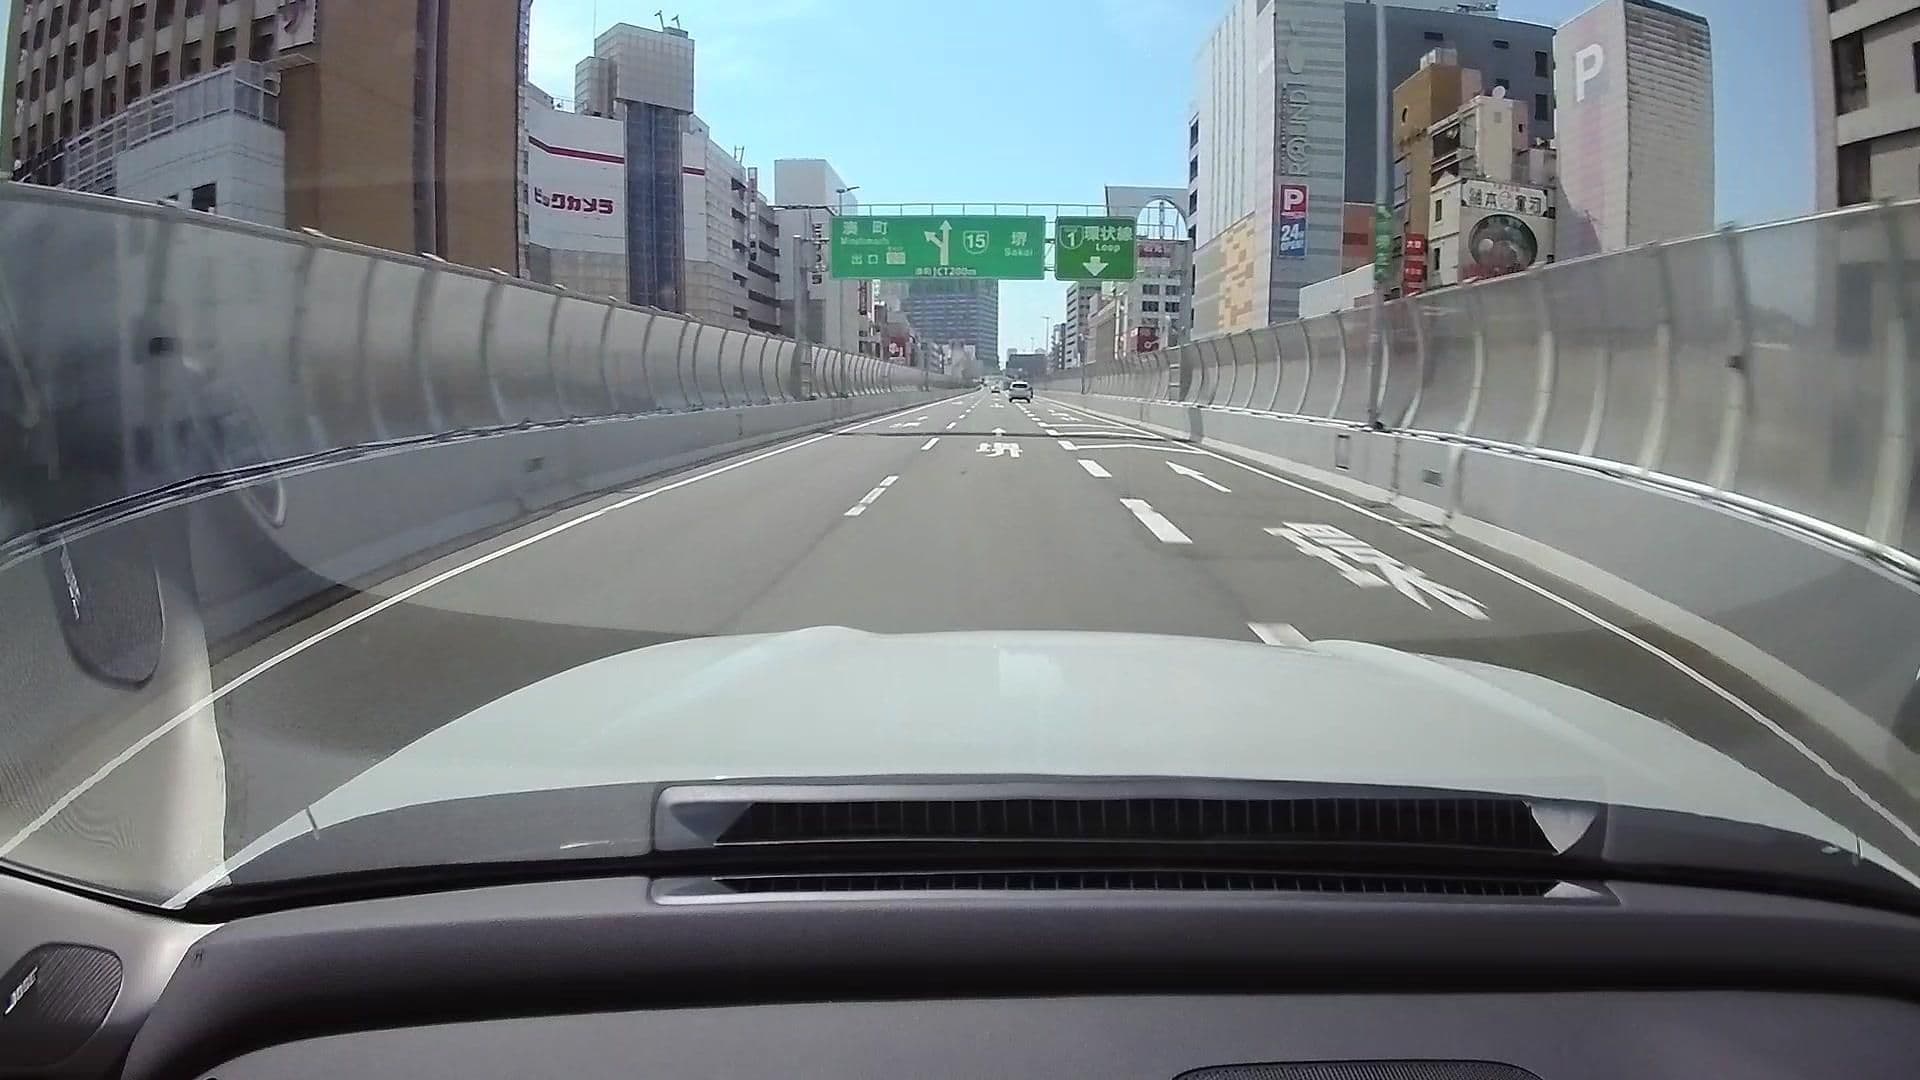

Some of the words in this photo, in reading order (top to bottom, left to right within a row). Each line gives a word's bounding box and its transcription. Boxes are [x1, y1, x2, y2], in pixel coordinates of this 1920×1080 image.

[1576, 44, 1603, 102] P
[534, 187, 614, 214] ビックカメラ
[1284, 189, 1304, 210] P
[1084, 226, 1133, 241] 環状線
[967, 234, 986, 249] 15
[1095, 243, 1121, 253] Loop
[851, 254, 879, 265] 出口
